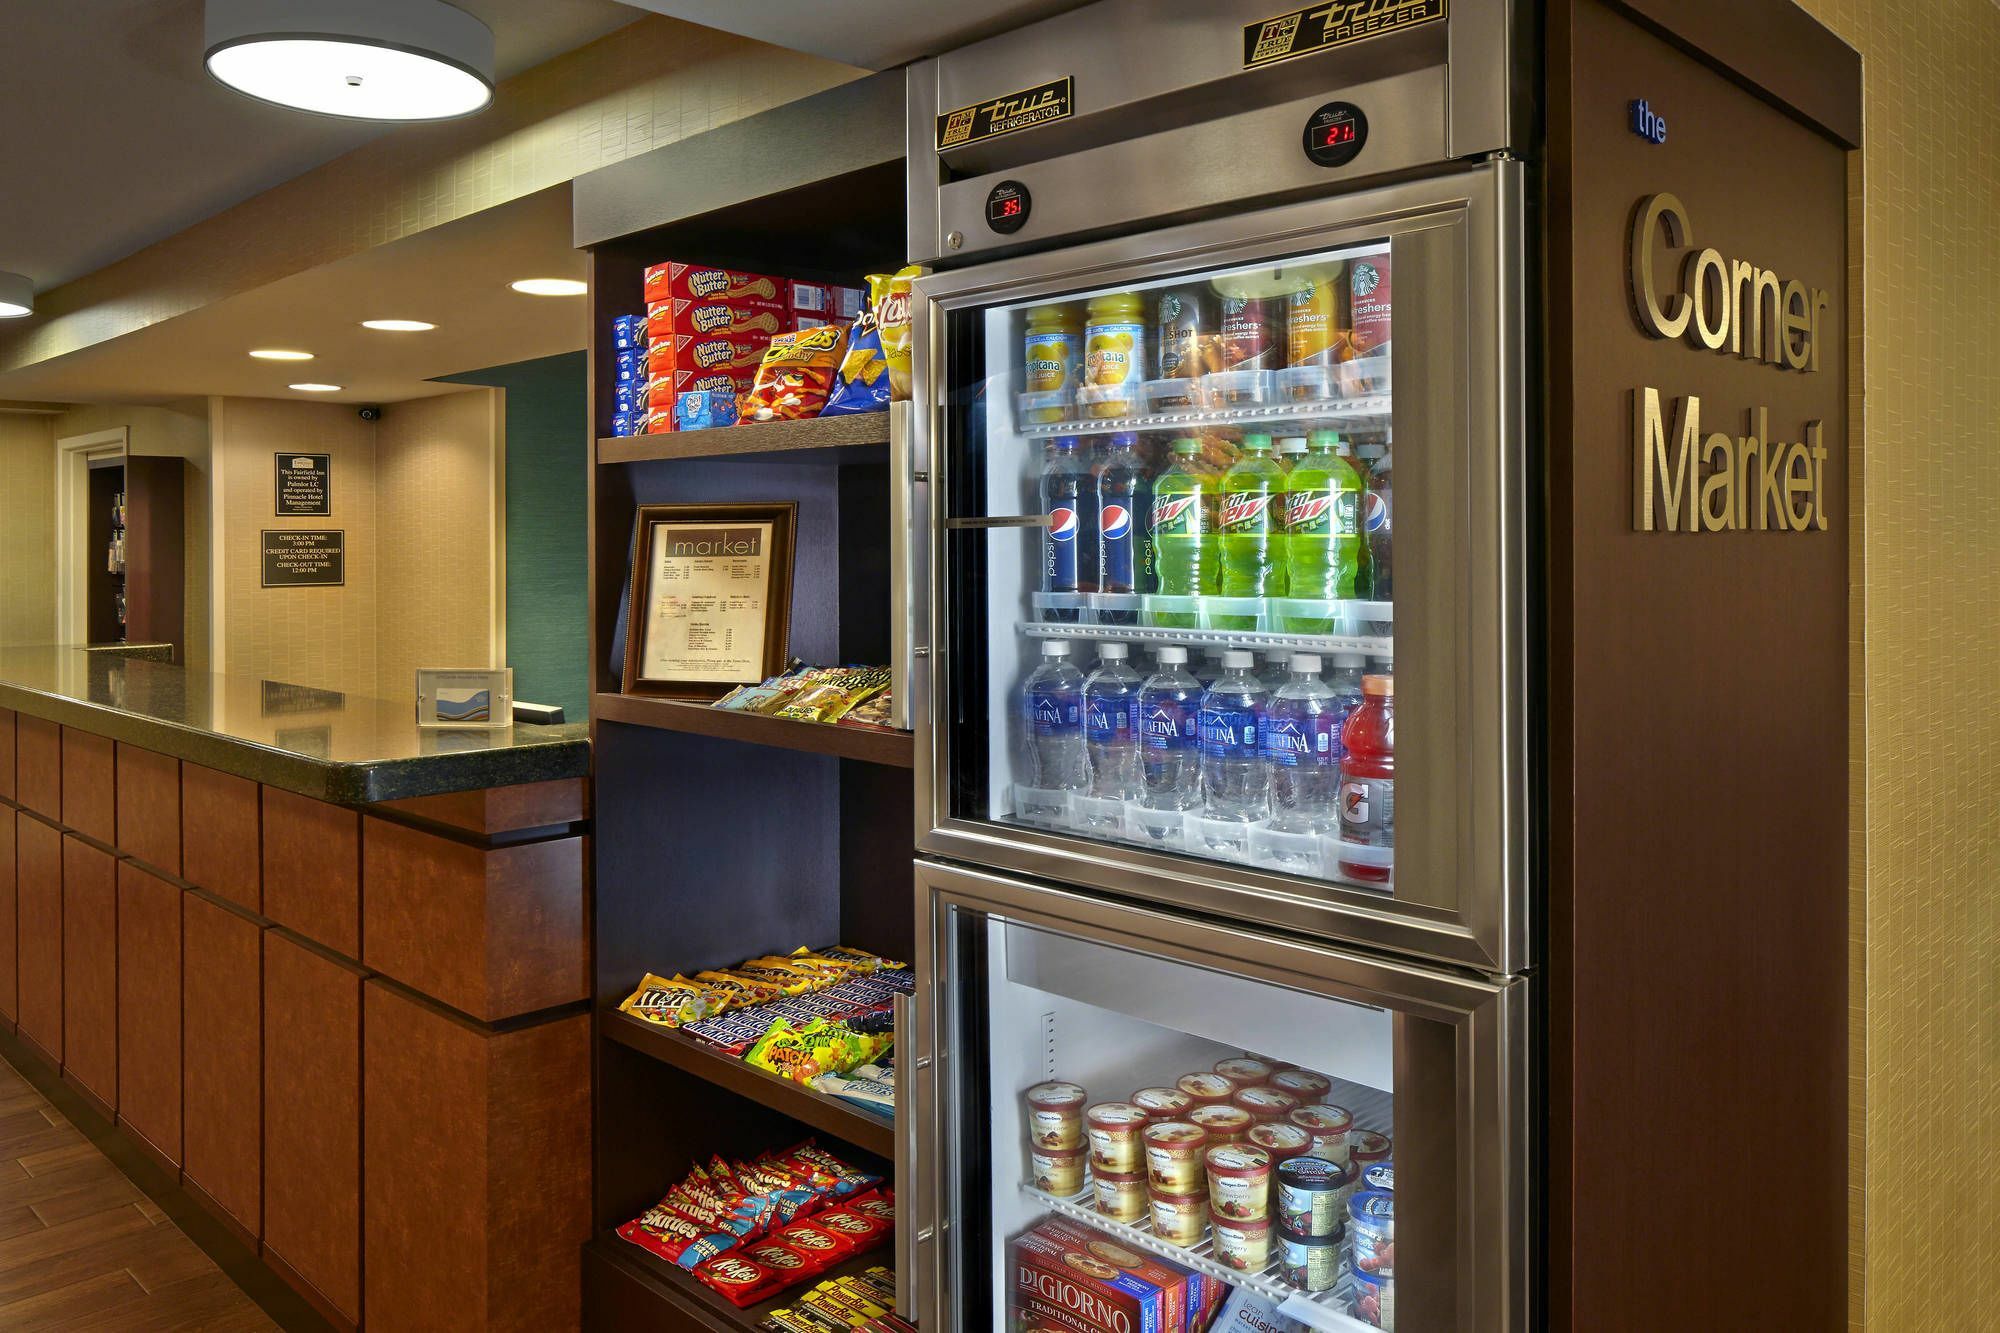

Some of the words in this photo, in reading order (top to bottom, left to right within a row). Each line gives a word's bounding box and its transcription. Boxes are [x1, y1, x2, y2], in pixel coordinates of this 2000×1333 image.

[1322, 5, 1427, 43] FREEZER
[980, 90, 1060, 122] true
[989, 105, 1060, 133] REFRIGERATOR
[1633, 98, 1668, 144] the
[1327, 126, 1349, 145] 21
[1004, 199, 1018, 216] 35
[691, 270, 724, 287] Nutter
[1634, 192, 1830, 373] Corner
[696, 280, 728, 297] Butter
[694, 306, 726, 322] Nutter
[700, 316, 731, 332] Butter
[1225, 322, 1258, 331] reshers
[1169, 329, 1193, 340] SHOT
[696, 340, 728, 357] Nutter
[702, 351, 732, 368] Butter
[696, 376, 728, 391] Nutter
[1634, 386, 1829, 532] Market
[674, 532, 757, 555] market
[1048, 542, 1056, 577] pepsi
[1100, 540, 1108, 576] pepsi
[1034, 708, 1062, 724] AFINA
[640, 1209, 701, 1239] Skittles
[692, 1244, 710, 1258] SIZE
[698, 1238, 720, 1256] SHARE
[827, 1284, 870, 1311] PowerBar
[1020, 1266, 1130, 1333] DIGIORNO
[812, 1294, 856, 1322] PowerBar
[1030, 1300, 1091, 1333] TRADITIONAL
[1243, 1300, 1265, 1318] lean
